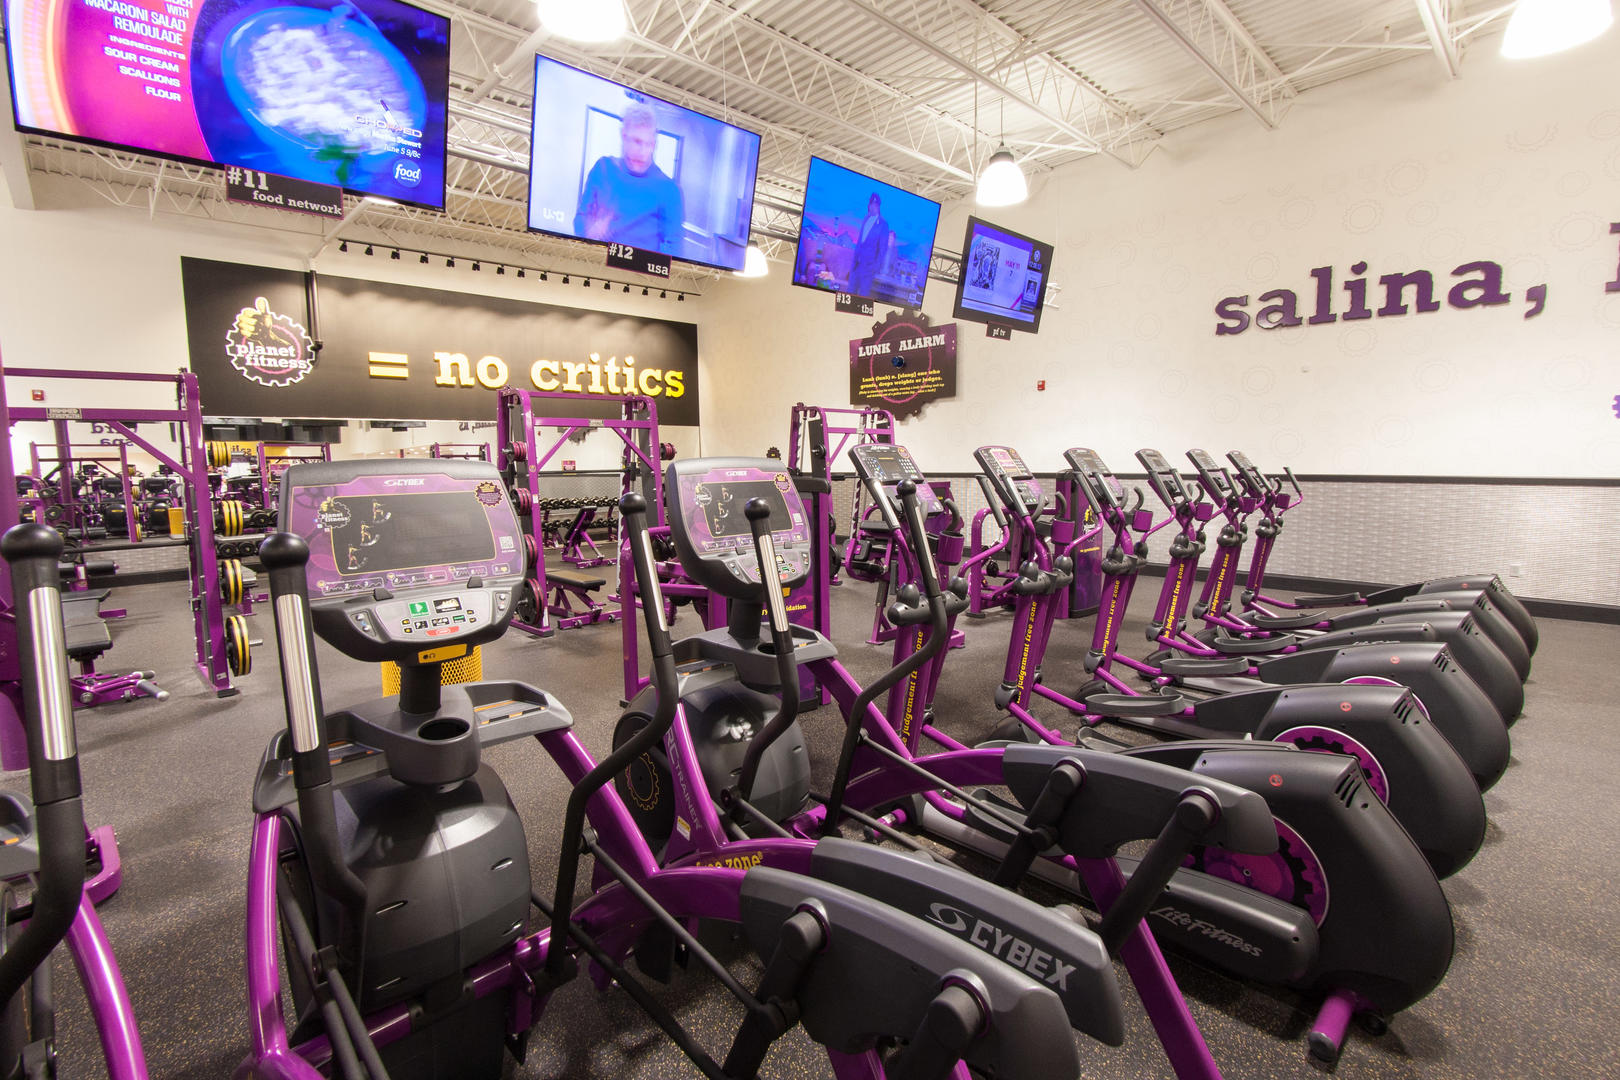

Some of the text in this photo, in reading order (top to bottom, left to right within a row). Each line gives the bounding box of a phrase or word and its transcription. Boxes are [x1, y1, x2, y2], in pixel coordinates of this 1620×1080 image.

[150, 11, 187, 32] SALAD
[166, 3, 189, 18] WITH
[113, 15, 183, 46] REMOULADE
[103, 46, 179, 73] SOUR CREAM
[119, 65, 180, 87] SCALLIONS
[144, 85, 181, 102] FLOUR
[227, 167, 269, 191] #11
[394, 163, 421, 179] food
[252, 190, 342, 215] food network
[609, 243, 634, 260] #12
[647, 263, 669, 276] usa
[836, 292, 851, 305] #13
[861, 303, 873, 315] tbs
[1214, 260, 1548, 336] salina,
[235, 341, 296, 357] planet
[858, 333, 946, 357] LUNK ALARM
[245, 354, 308, 369] fitness
[433, 350, 509, 389] no
[529, 351, 686, 399] critics
[1165, 595, 1178, 630] judgement
[1173, 580, 1181, 594] free
[1177, 563, 1185, 579] zone
[1017, 643, 1029, 690] judgement
[1024, 624, 1033, 642] free
[1029, 601, 1037, 622] zone
[903, 681, 916, 736] judgement
[969, 919, 1077, 992] CYBEX
